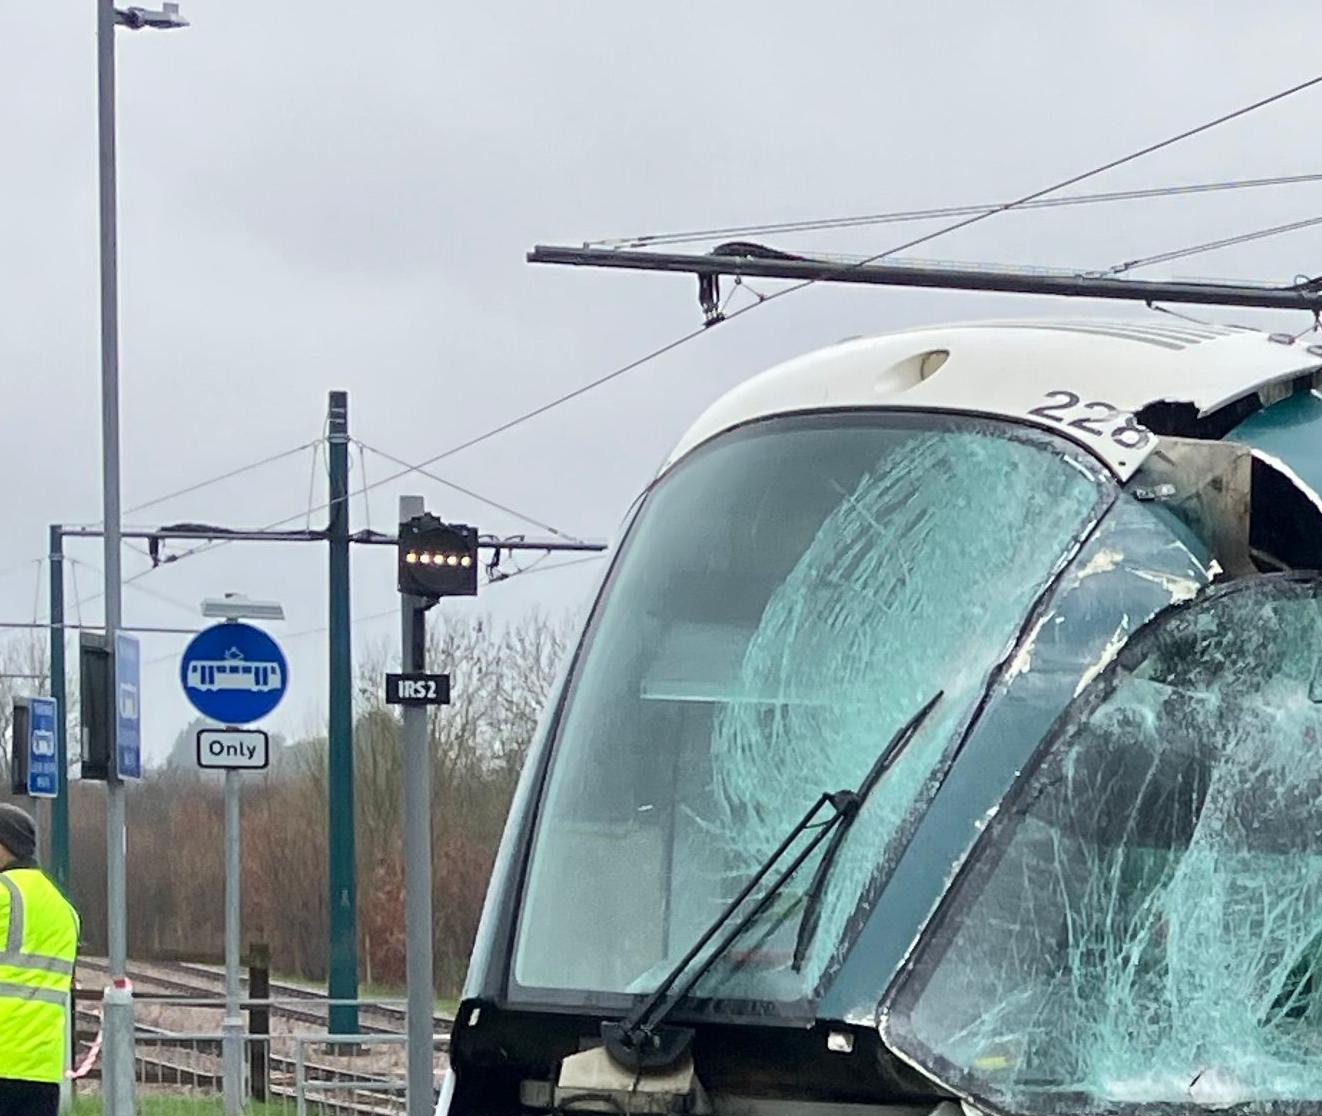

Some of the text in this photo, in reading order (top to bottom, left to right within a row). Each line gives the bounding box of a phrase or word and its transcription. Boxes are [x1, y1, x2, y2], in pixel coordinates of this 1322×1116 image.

[1028, 390, 1150, 449] 228
[397, 680, 437, 698] IRS2
[209, 739, 257, 760] Only
